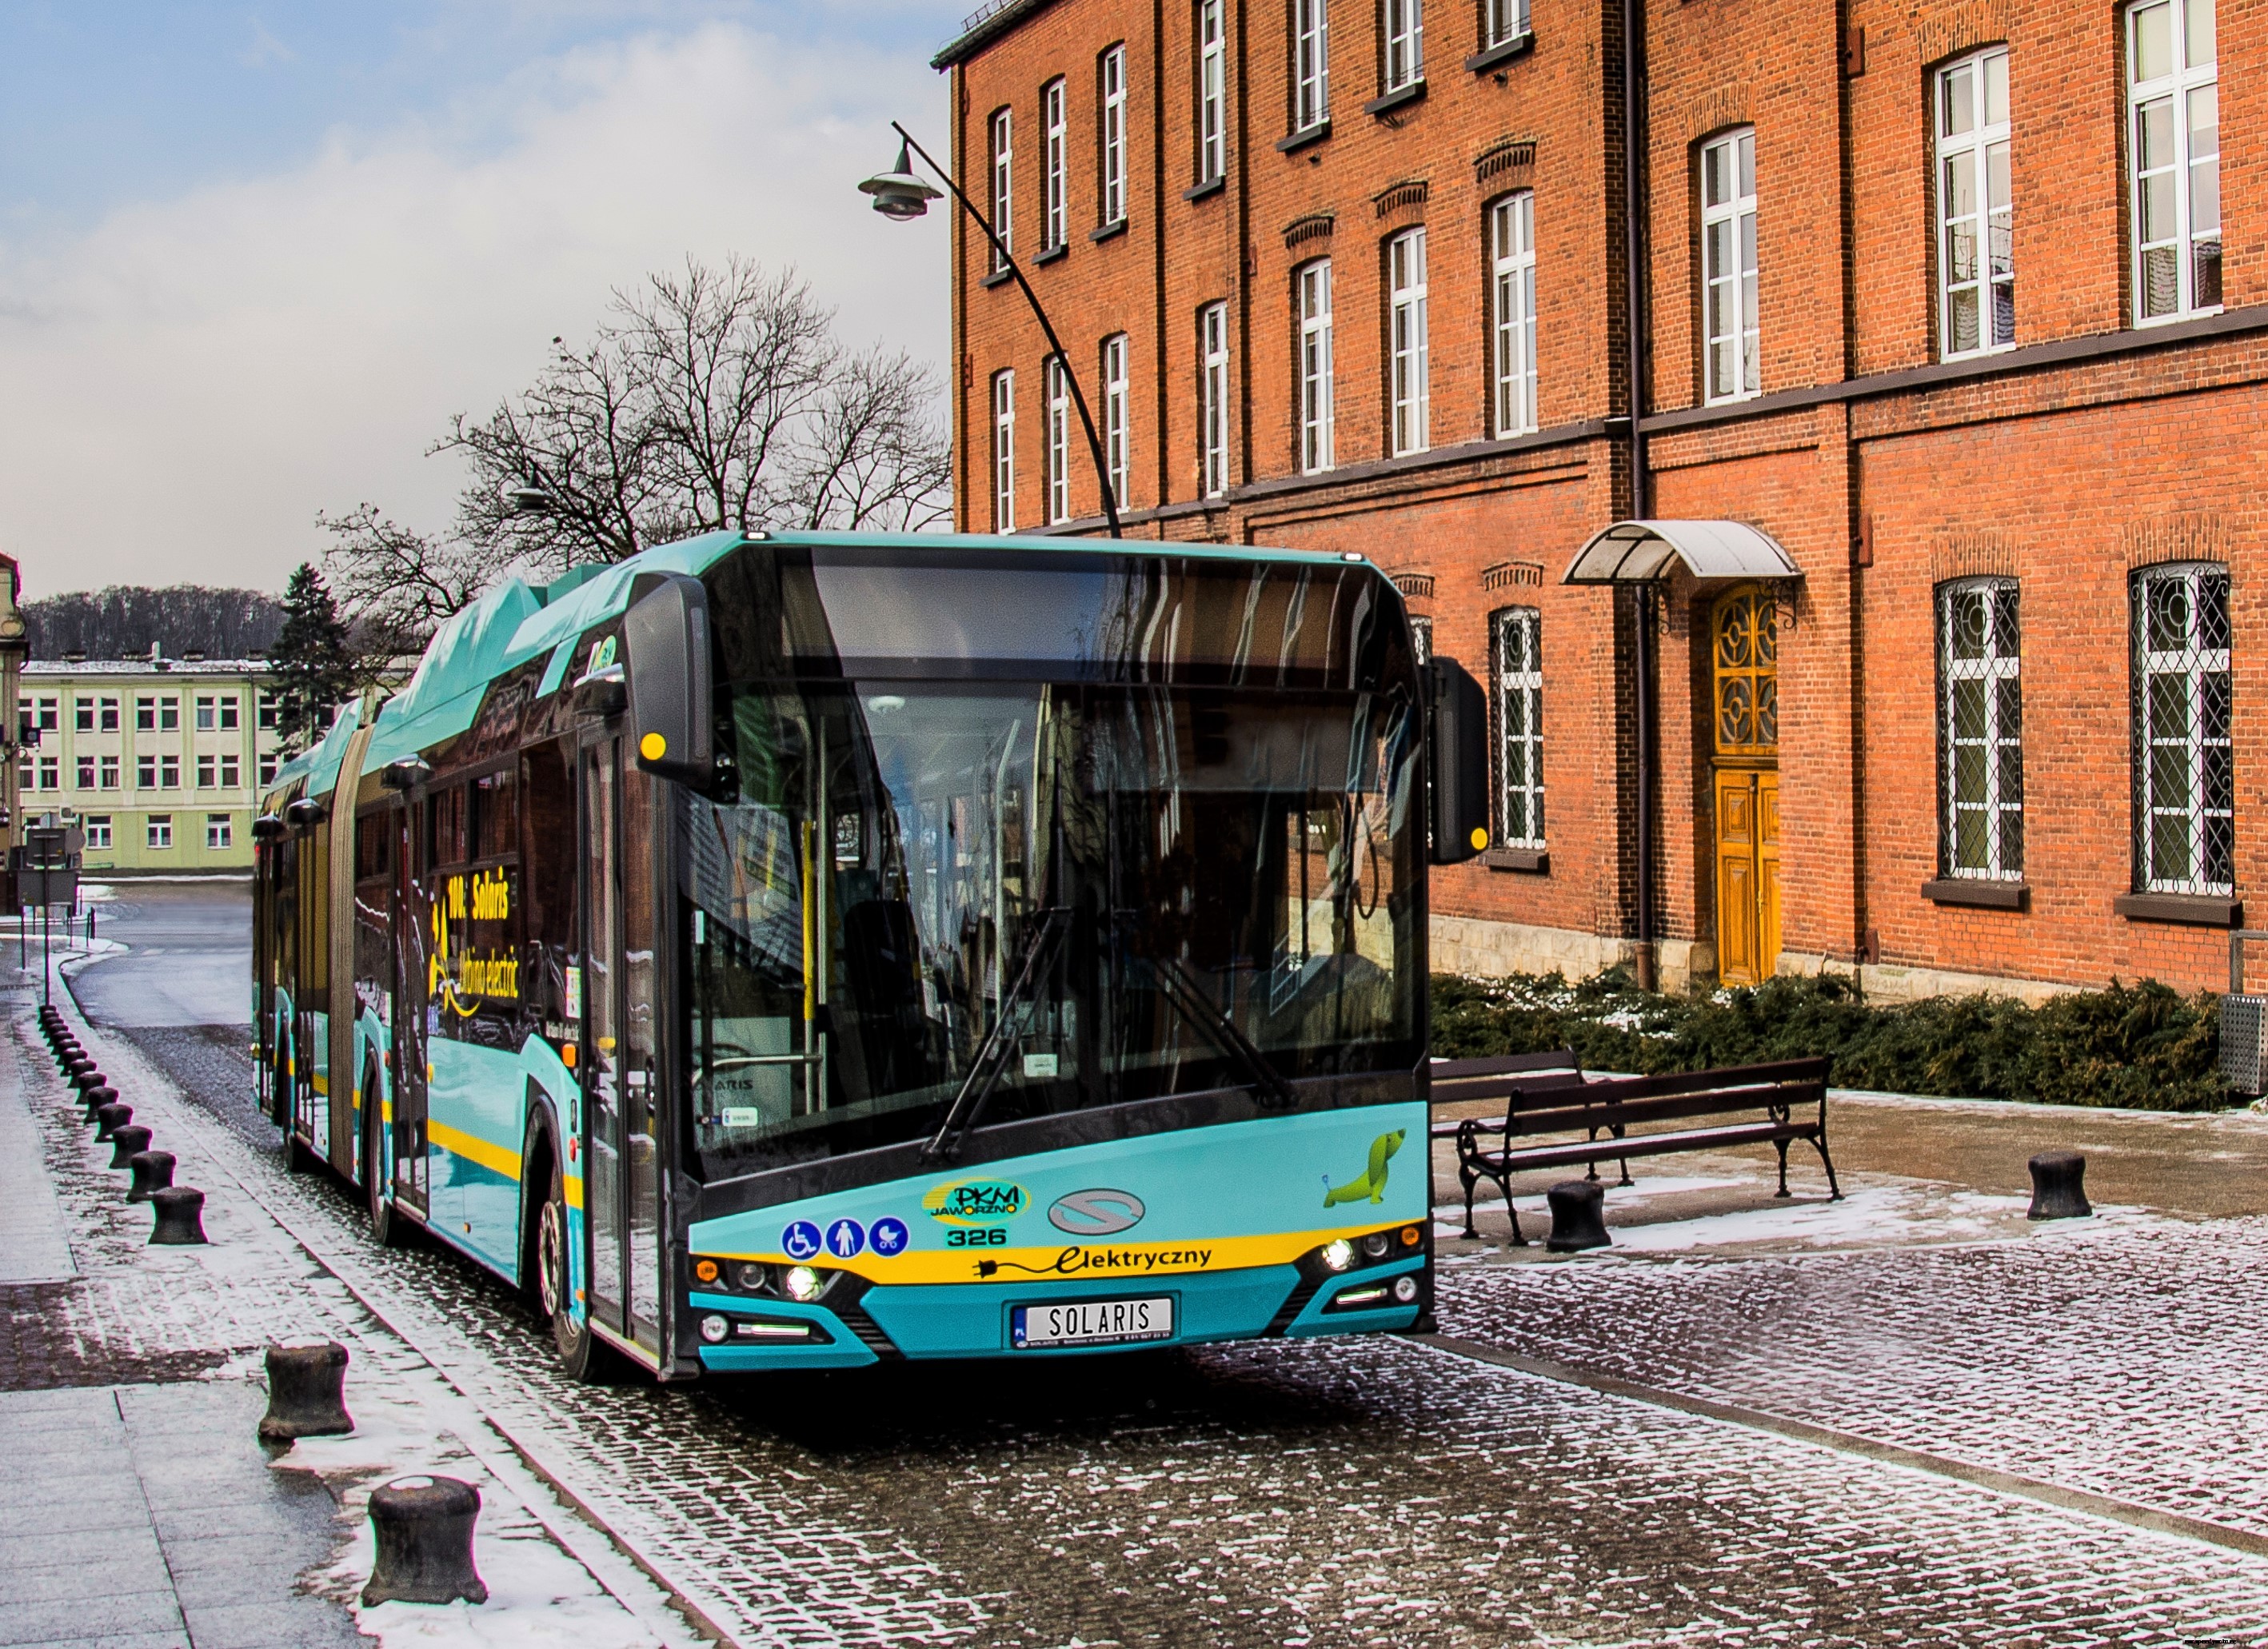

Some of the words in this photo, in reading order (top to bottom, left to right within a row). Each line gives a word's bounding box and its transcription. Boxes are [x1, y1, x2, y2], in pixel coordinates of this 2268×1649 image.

[473, 865, 508, 920] Solaris
[486, 944, 518, 999] electric
[930, 1203, 1016, 1216] JAWORZNO
[954, 1185, 1019, 1206] PKM
[947, 1228, 1007, 1247] 326
[1056, 1245, 1212, 1274] elektryczny
[1049, 1302, 1149, 1336] SOLARIS
